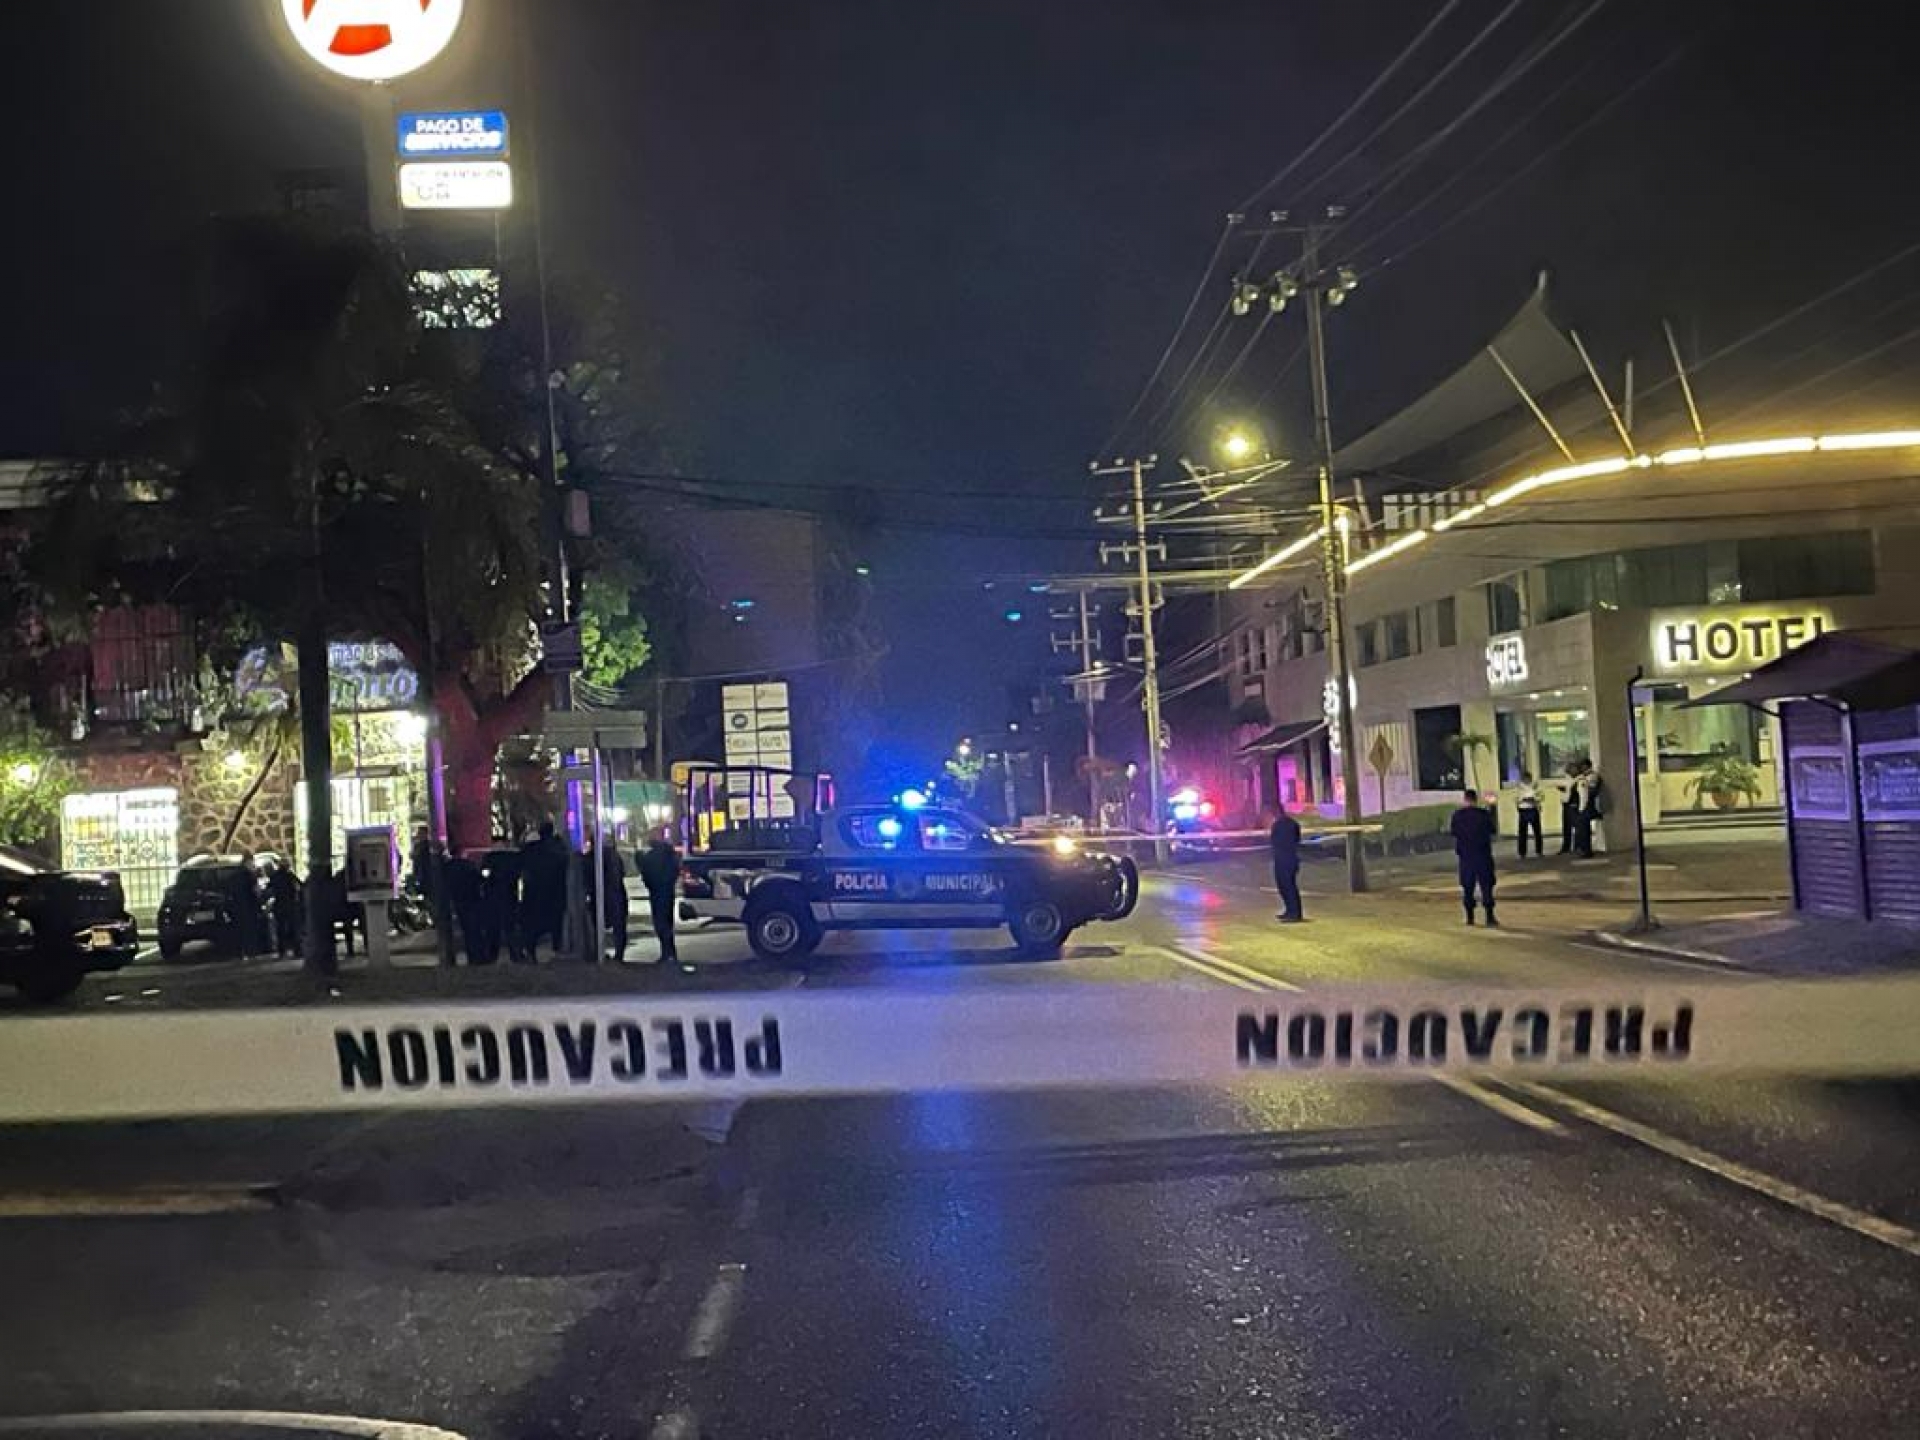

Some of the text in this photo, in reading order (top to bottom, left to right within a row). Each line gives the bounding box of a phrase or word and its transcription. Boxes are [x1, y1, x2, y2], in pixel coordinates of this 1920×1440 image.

[416, 117, 483, 133] PAGO DE
[835, 873, 996, 891] POLICIA MUNICIPAL
[334, 1016, 782, 1092] PRECAUCION
[1236, 1005, 1694, 1067] PRECAUCION
